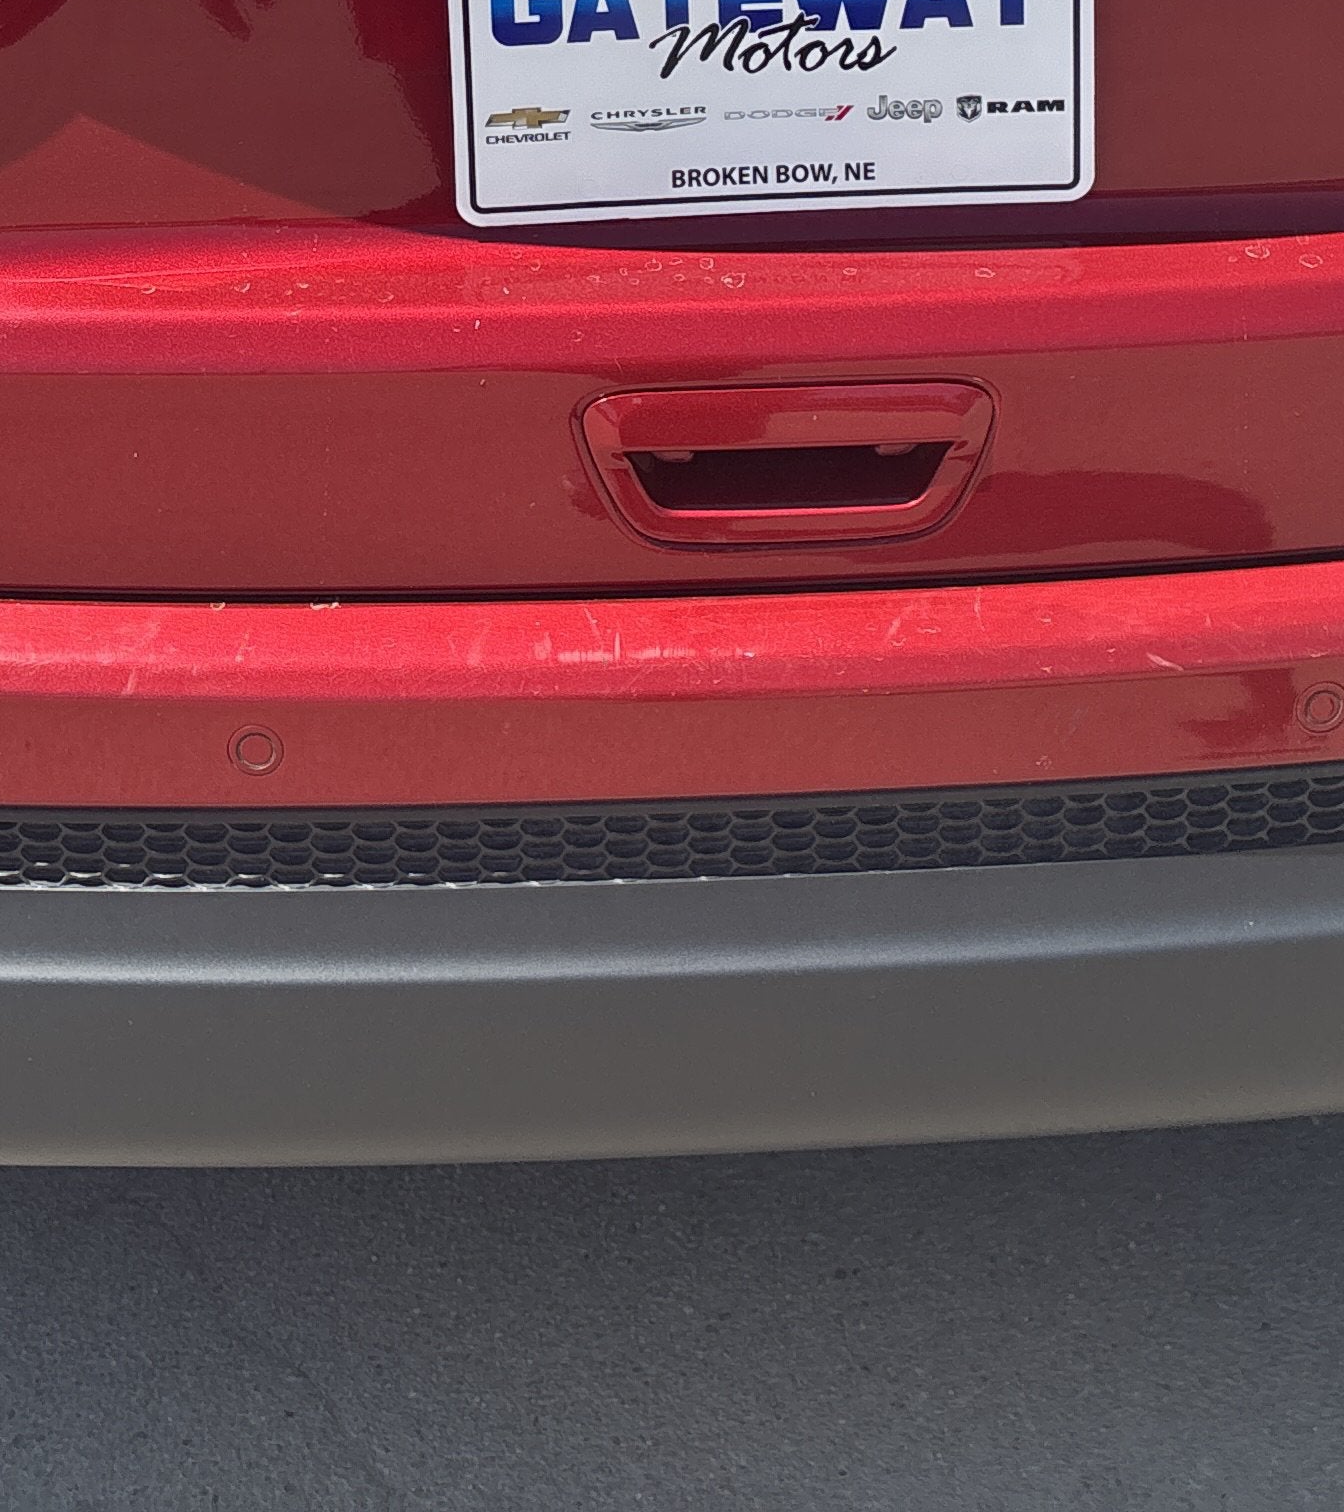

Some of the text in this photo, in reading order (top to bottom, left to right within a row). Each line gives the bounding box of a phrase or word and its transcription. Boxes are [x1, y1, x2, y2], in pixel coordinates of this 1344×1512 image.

[649, 11, 898, 80] Motors
[590, 106, 707, 120] CHRYSLER
[866, 94, 944, 124] Jeep
[986, 99, 1066, 114] RAM
[485, 131, 571, 145] CHEVROLET
[671, 162, 876, 188] BROKEN BOW, NE
